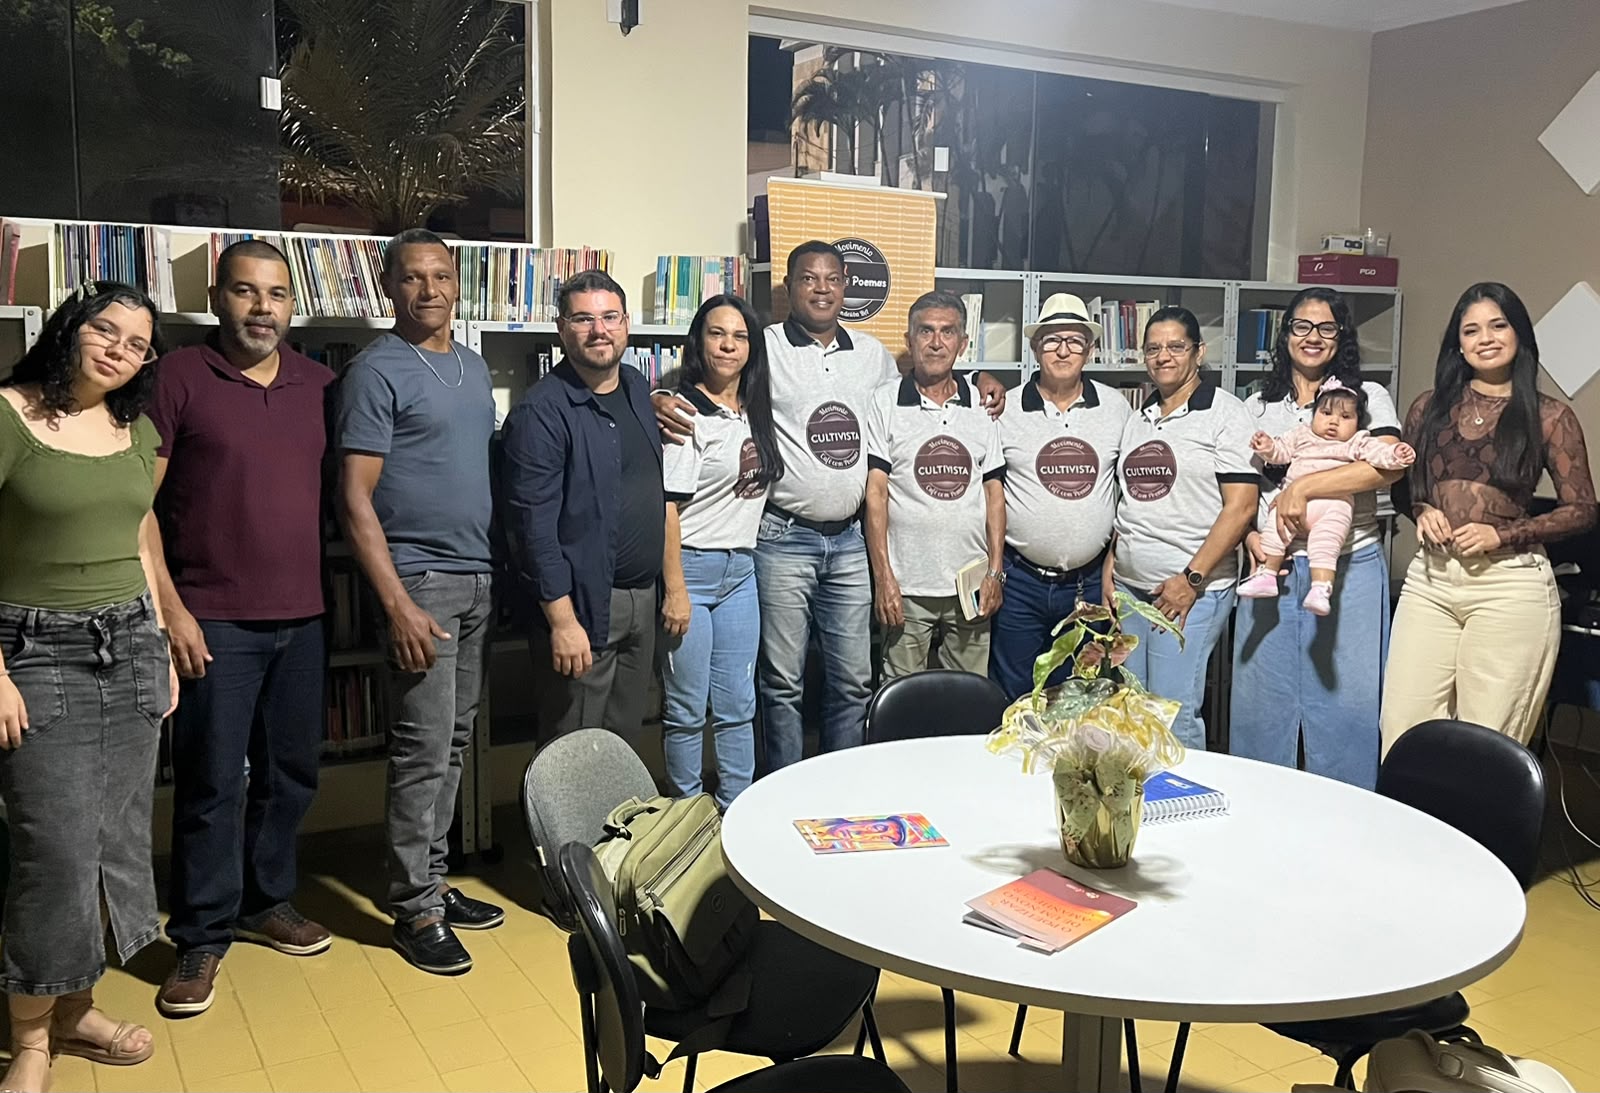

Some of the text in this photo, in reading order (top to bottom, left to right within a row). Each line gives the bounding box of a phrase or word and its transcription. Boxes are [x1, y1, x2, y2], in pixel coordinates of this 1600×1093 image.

[1359, 268, 1377, 276] PGO
[852, 275, 887, 288] Poemas
[810, 431, 860, 444] CULTIVISTA
[917, 464, 969, 476] CULTIVISTA
[1040, 464, 1097, 475] CULTIVISTA
[1125, 466, 1173, 477] CULTIVISTA
